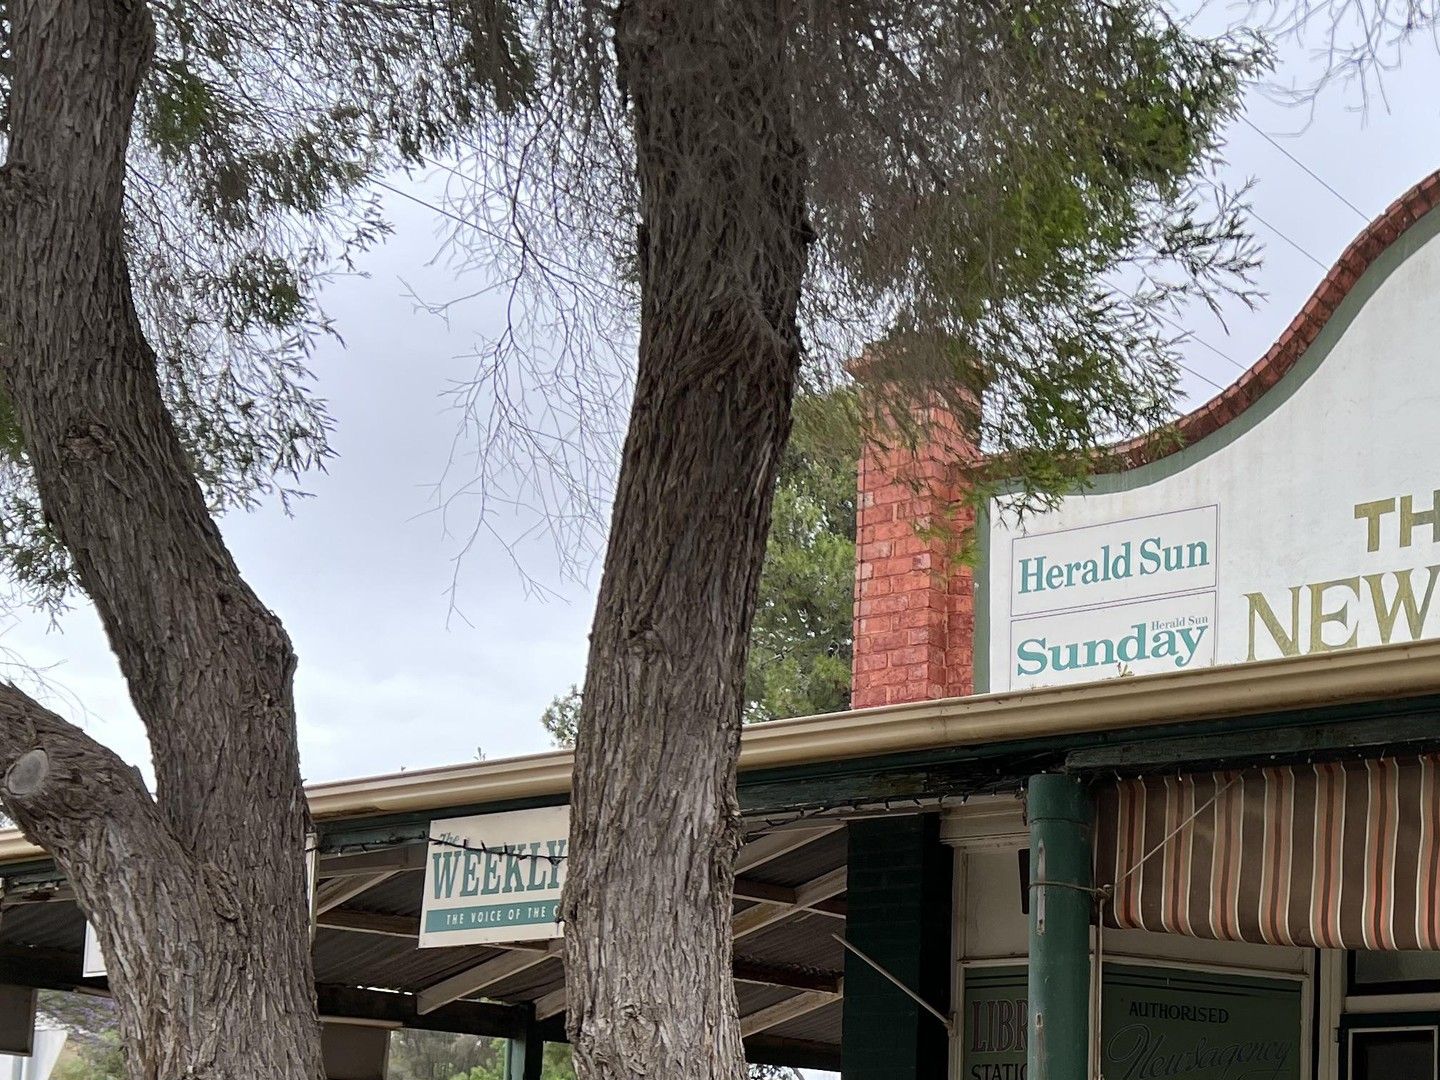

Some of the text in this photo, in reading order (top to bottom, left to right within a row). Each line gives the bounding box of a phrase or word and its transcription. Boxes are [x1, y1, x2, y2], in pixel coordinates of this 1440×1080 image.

[1018, 537, 1210, 594] Herald Sun
[1151, 615, 1209, 632] Herald Sun
[1017, 623, 1208, 676] Sunday
[432, 839, 567, 899] WEEKLY
[446, 914, 464, 925] THE
[471, 909, 501, 922] VOICE
[508, 908, 521, 920] OF
[528, 906, 546, 917] THE
[1129, 1001, 1229, 1024] AUTHORISED
